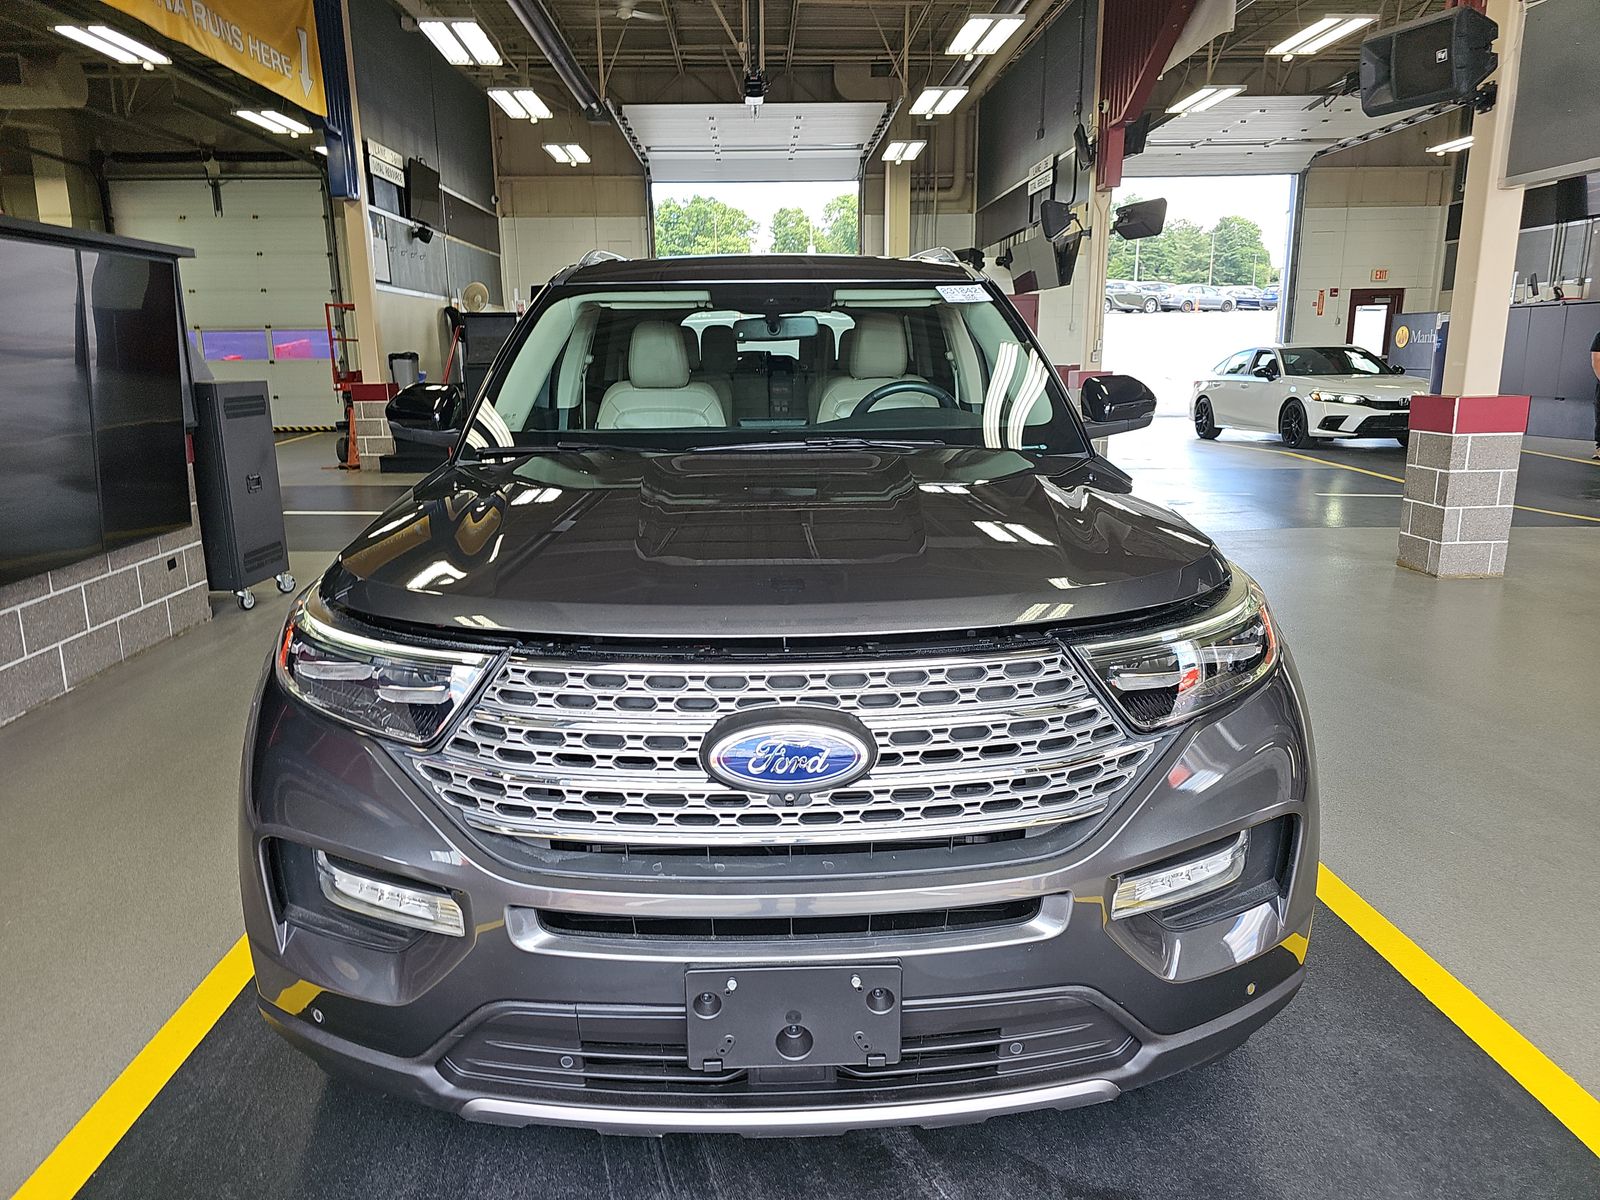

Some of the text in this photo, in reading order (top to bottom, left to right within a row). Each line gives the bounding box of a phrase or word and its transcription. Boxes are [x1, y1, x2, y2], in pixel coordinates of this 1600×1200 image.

[192, 0, 293, 79] RUNS HERE
[1376, 270, 1387, 279] EXIT
[747, 739, 831, 774] Ford
